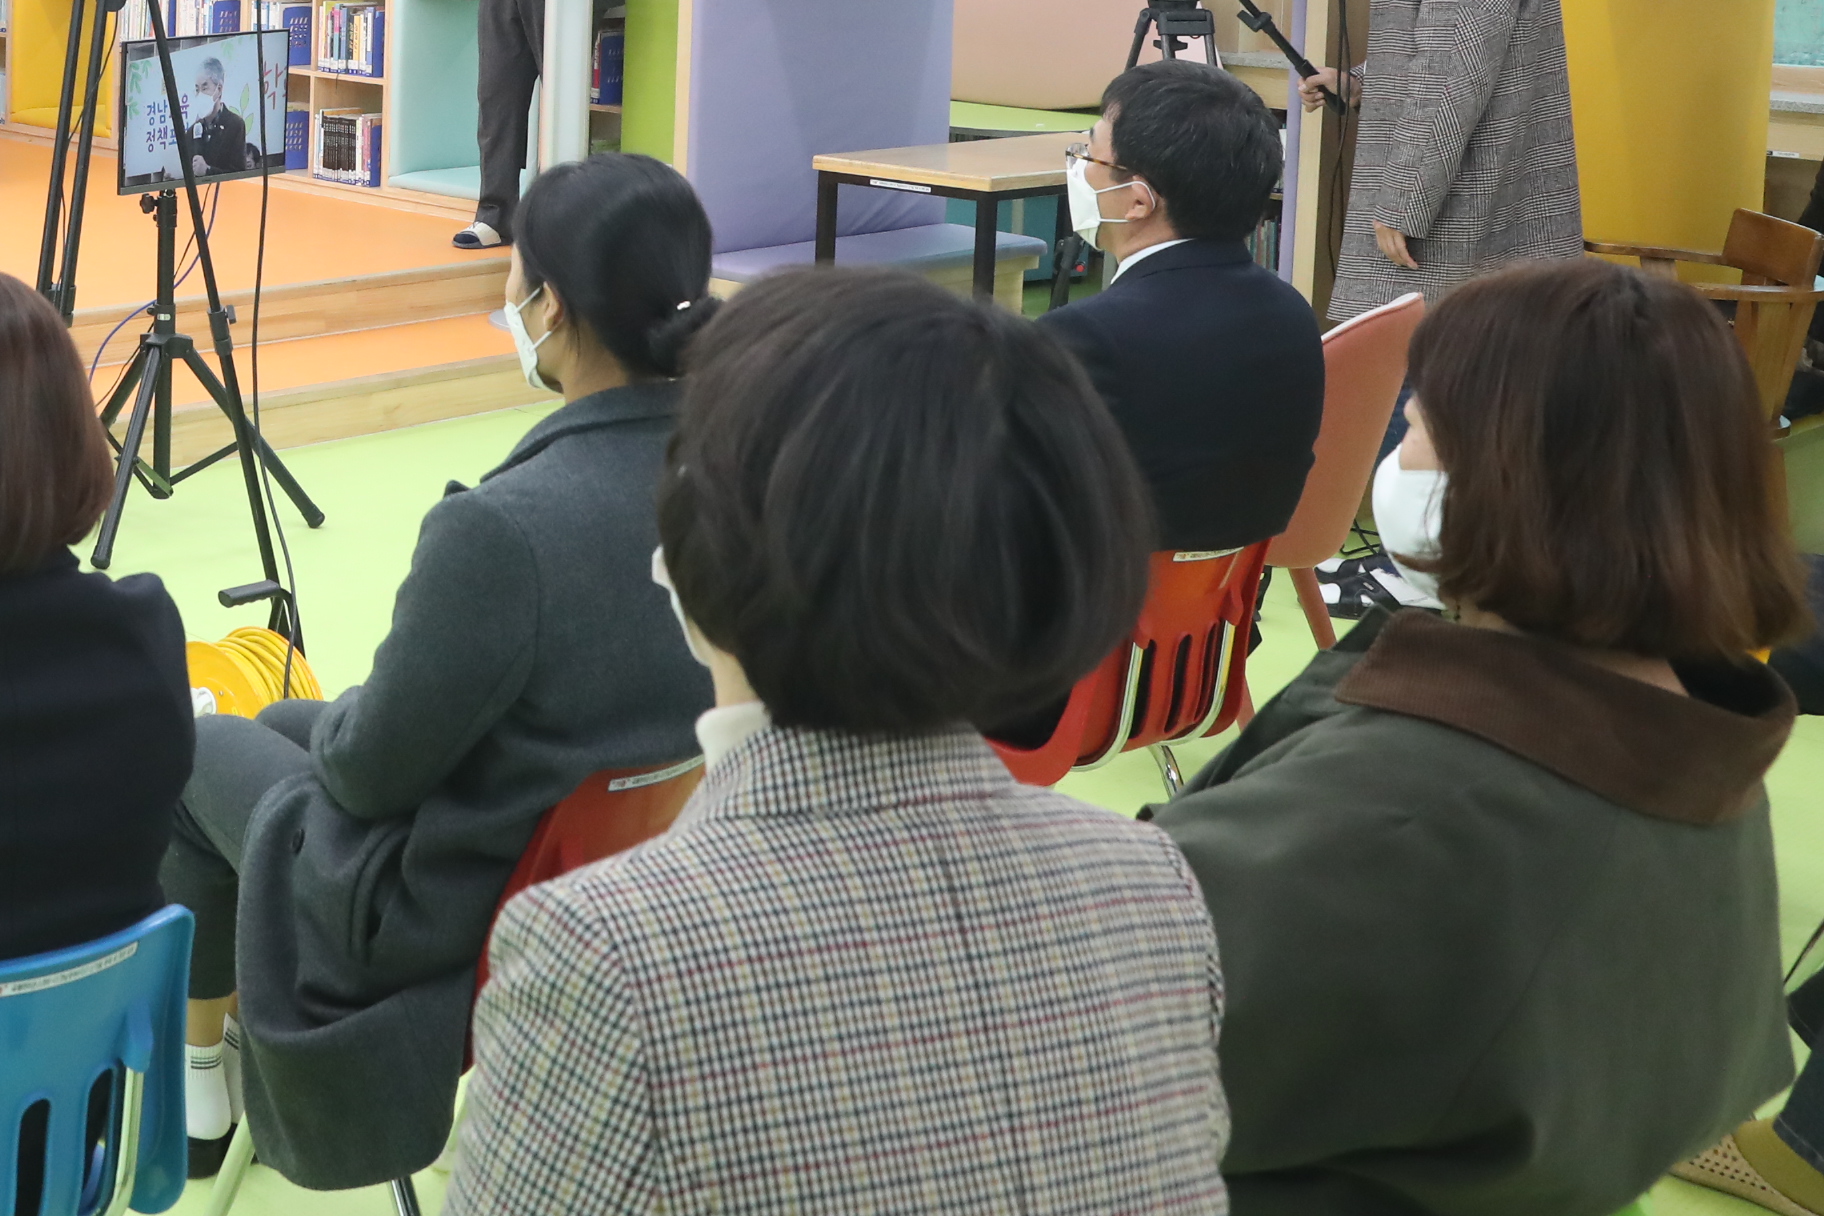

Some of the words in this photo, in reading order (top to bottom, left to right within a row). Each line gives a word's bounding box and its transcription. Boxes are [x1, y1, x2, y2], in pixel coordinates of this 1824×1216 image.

[263, 60, 287, 110] 학
[146, 93, 190, 126] 경남육
[146, 124, 188, 153] 정책포
